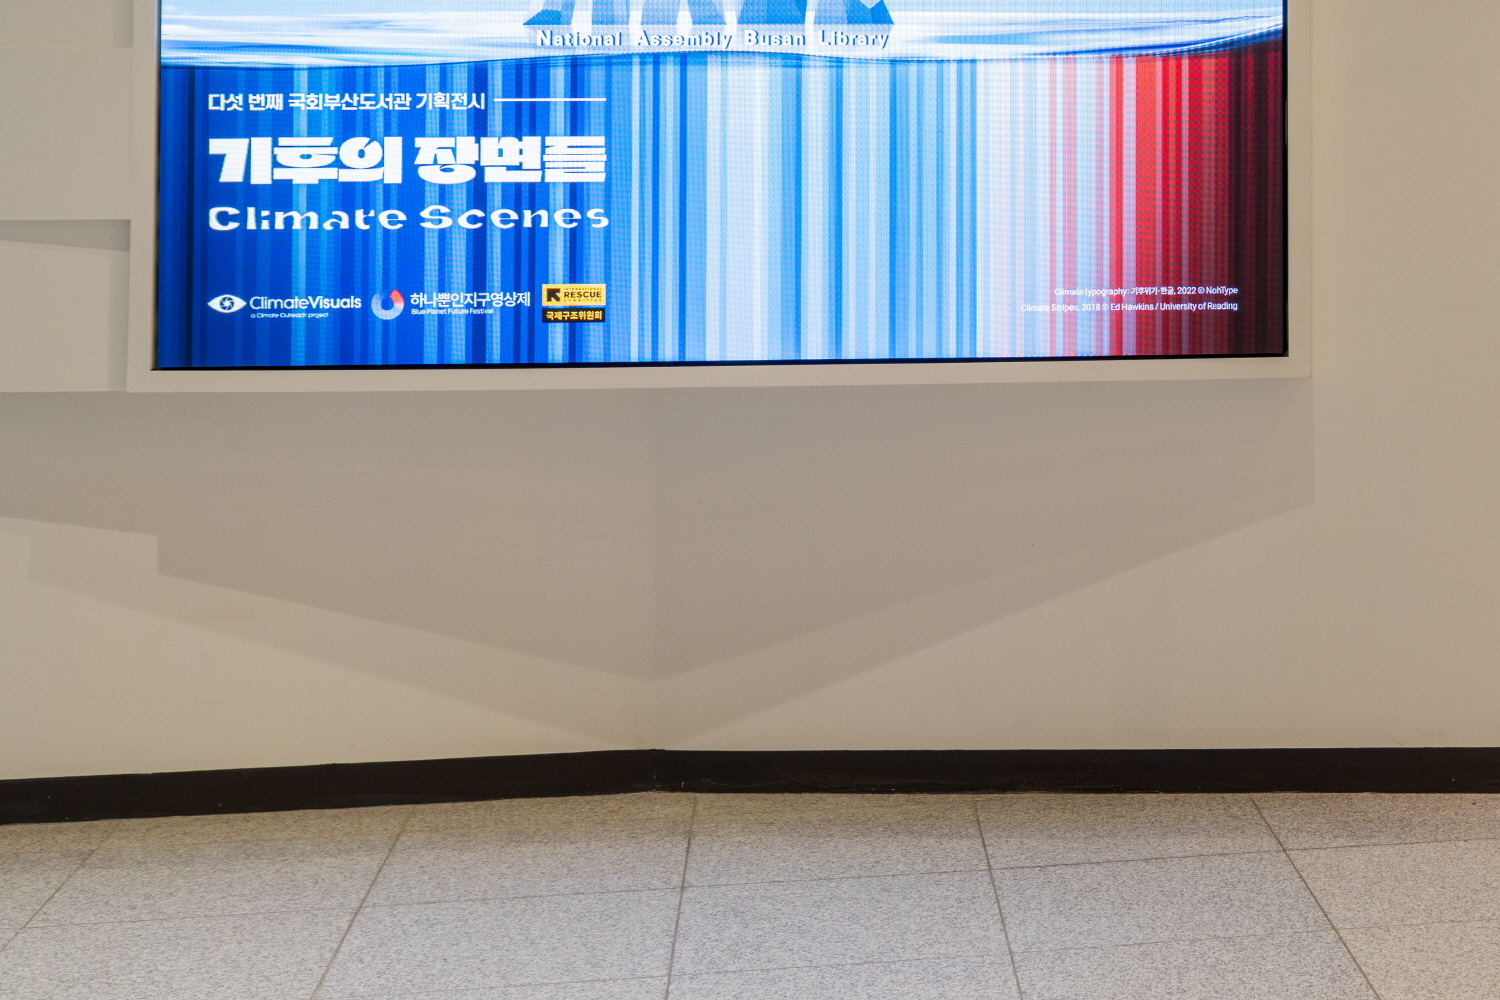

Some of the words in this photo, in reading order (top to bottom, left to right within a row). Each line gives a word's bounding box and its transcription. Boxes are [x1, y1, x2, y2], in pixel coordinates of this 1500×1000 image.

[536, 29, 622, 47] National
[637, 29, 732, 49] Assembly
[743, 29, 806, 47] Busan
[818, 29, 889, 50] Library
[208, 93, 244, 111] 다섯
[248, 93, 283, 111] 번째
[288, 92, 411, 111] 국회부산도서관
[415, 92, 486, 111] 기획전시
[208, 136, 402, 185] 기후의
[414, 136, 607, 185] 장면들
[208, 206, 407, 232] Climate
[419, 204, 610, 230] Scenes
[410, 291, 531, 308] 하나뿐인지구영상제
[1054, 288, 1083, 296] Climate
[1084, 287, 1130, 297] typography:
[1177, 286, 1197, 295] 2022
[1206, 286, 1238, 296] NohType
[249, 295, 362, 310] ClimateVisuals
[1021, 303, 1050, 312] Climate
[1051, 303, 1081, 313] Stripes,
[1081, 302, 1101, 311] 2018
[1110, 303, 1121, 311] Ed
[1121, 302, 1154, 311] Hawkins
[1160, 302, 1197, 312] University
[1198, 302, 1207, 310] of
[1207, 301, 1238, 311] Reading
[308, 312, 329, 320] project
[545, 311, 603, 321] 국제구조위원회
